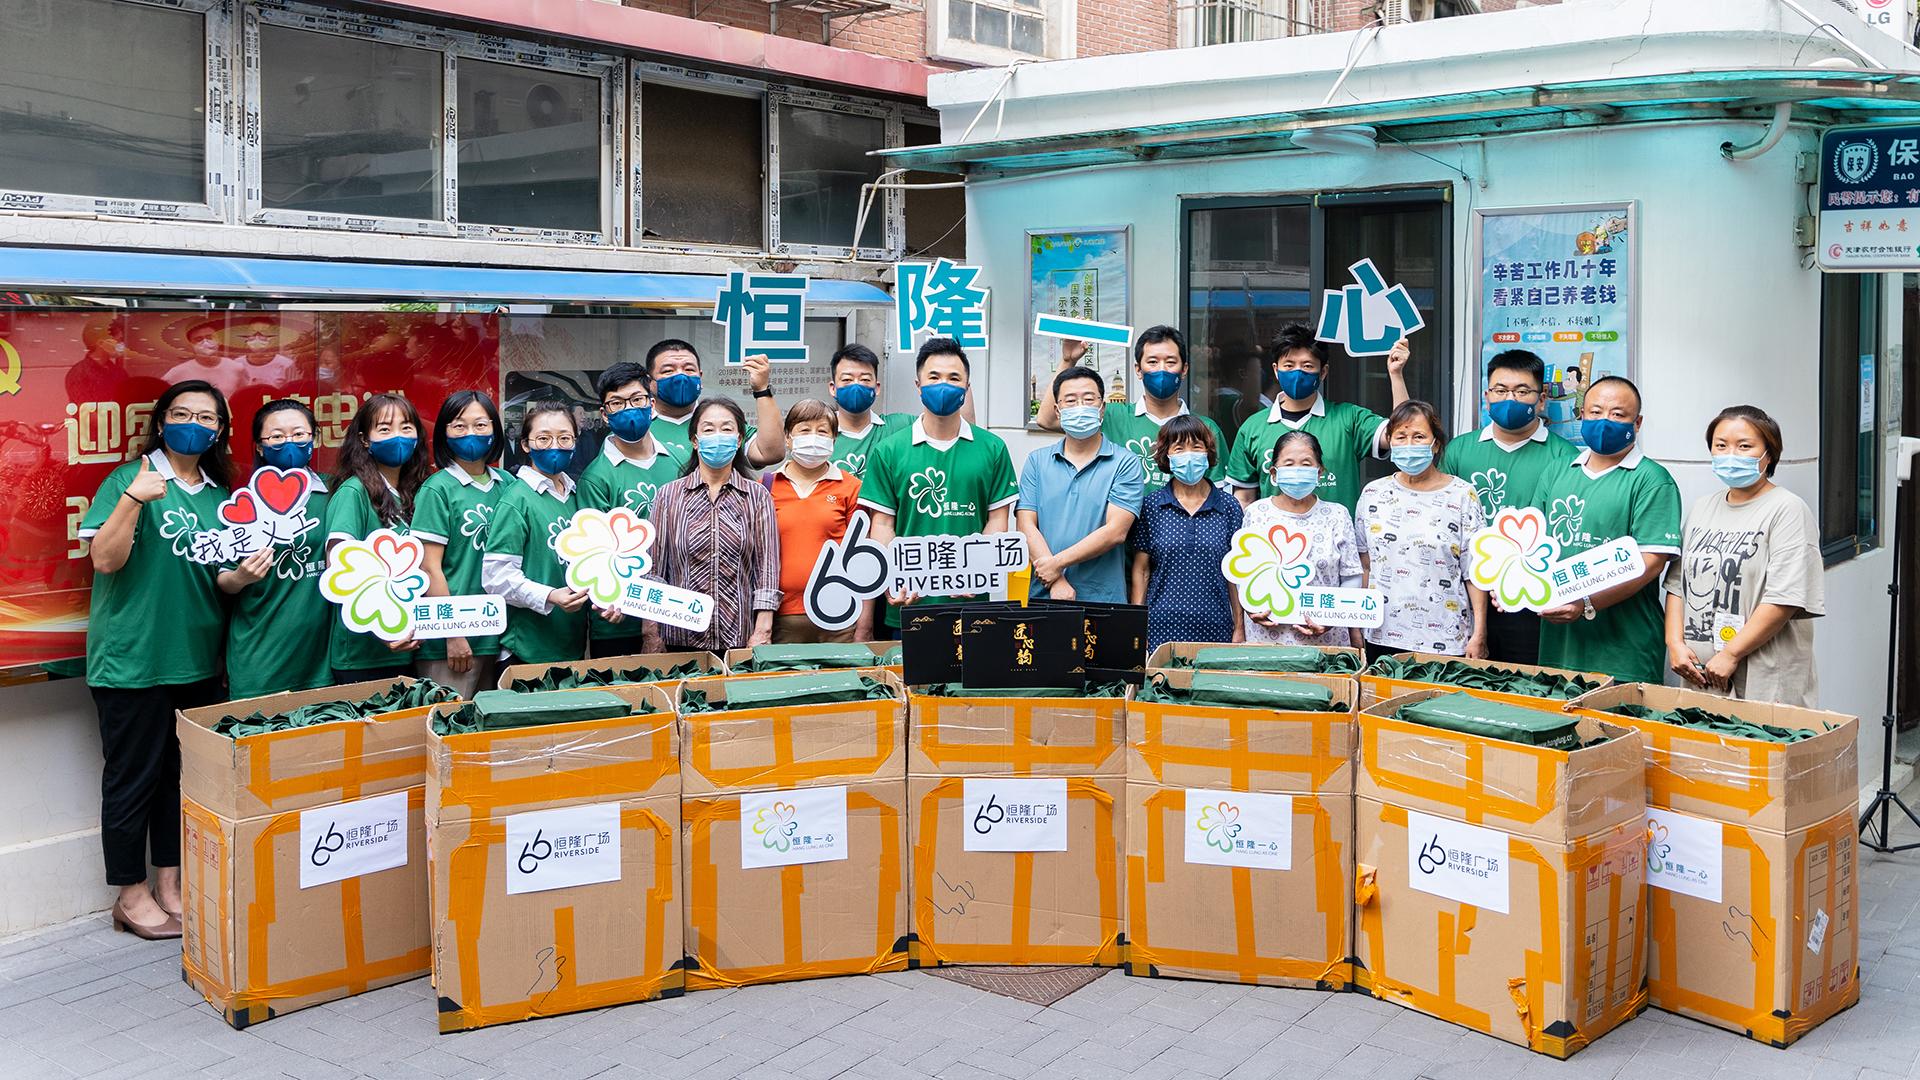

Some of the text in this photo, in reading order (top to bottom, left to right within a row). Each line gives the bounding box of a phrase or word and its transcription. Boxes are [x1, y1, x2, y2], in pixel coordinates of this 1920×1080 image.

[1867, 11, 1891, 25] LG
[1887, 139, 1920, 167] 保
[1893, 172, 1915, 181] BAO
[1843, 219, 1908, 232] 吉祥如意
[1493, 258, 1617, 281] 辛苦工作几十年
[897, 261, 986, 350] 隆
[1493, 284, 1617, 307] 看紧自己养老钱
[716, 272, 807, 363] 恒
[1319, 262, 1421, 354] 心
[1038, 317, 1131, 344] 一
[196, 510, 317, 561] 我是义工
[893, 537, 1024, 572] 恒隆广场
[1551, 546, 1631, 588] 恒隆一心
[895, 572, 1000, 593] RIVERSIDE
[1557, 562, 1636, 598] HANG LUNG AS ONE
[626, 582, 704, 615] 恒隆一心
[1299, 592, 1377, 611] 恒隆一心
[413, 601, 499, 621] 恒隆一心
[623, 599, 702, 625] HANG LUNG AS ONE
[1324, 611, 1347, 619] LUNG
[1348, 612, 1358, 620] AS
[1360, 613, 1377, 621] ONE
[414, 619, 500, 632] HANG LUNG AS ONE
[1006, 804, 1058, 816] 恒隆广场
[346, 819, 399, 841] 恒隆广场
[554, 831, 610, 850] 恒隆广场
[792, 833, 834, 846] 恒隆一心
[346, 834, 389, 850] RIVERSIDE
[554, 846, 600, 859] RIVERSIDE
[1235, 839, 1278, 851] 恒隆一心
[1447, 862, 1489, 879] RIVERSIDE
[1448, 848, 1499, 872] 恒隆广场
[1665, 861, 1708, 880] 恒隆一心
